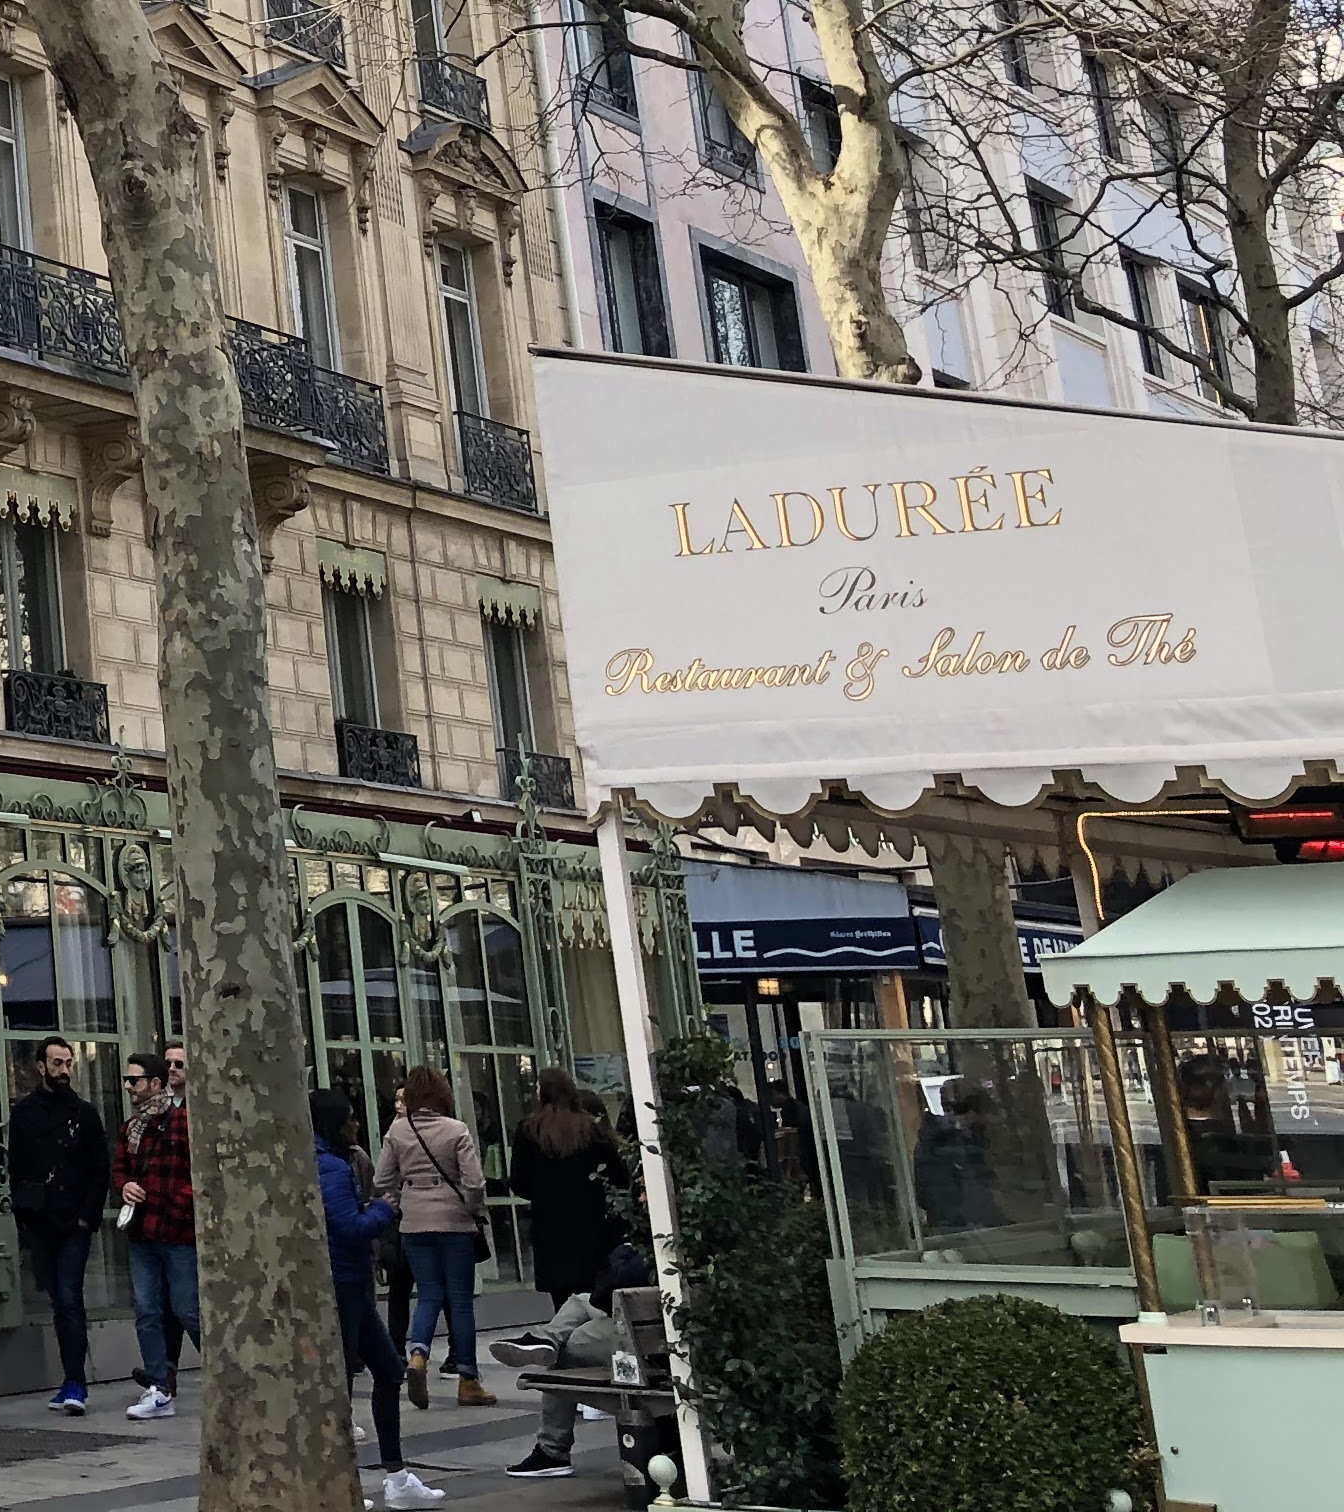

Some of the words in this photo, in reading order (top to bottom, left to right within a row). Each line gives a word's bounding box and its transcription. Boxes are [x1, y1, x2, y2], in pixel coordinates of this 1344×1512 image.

[669, 465, 1063, 557] LADURÉE
[819, 566, 928, 615] Paris
[605, 648, 836, 696] Restaurant
[843, 642, 889, 701] &
[901, 627, 1030, 678] Salon
[1040, 625, 1090, 670] de
[1106, 613, 1197, 667] Thé
[1273, 1002, 1311, 1120] RINTEMPS
